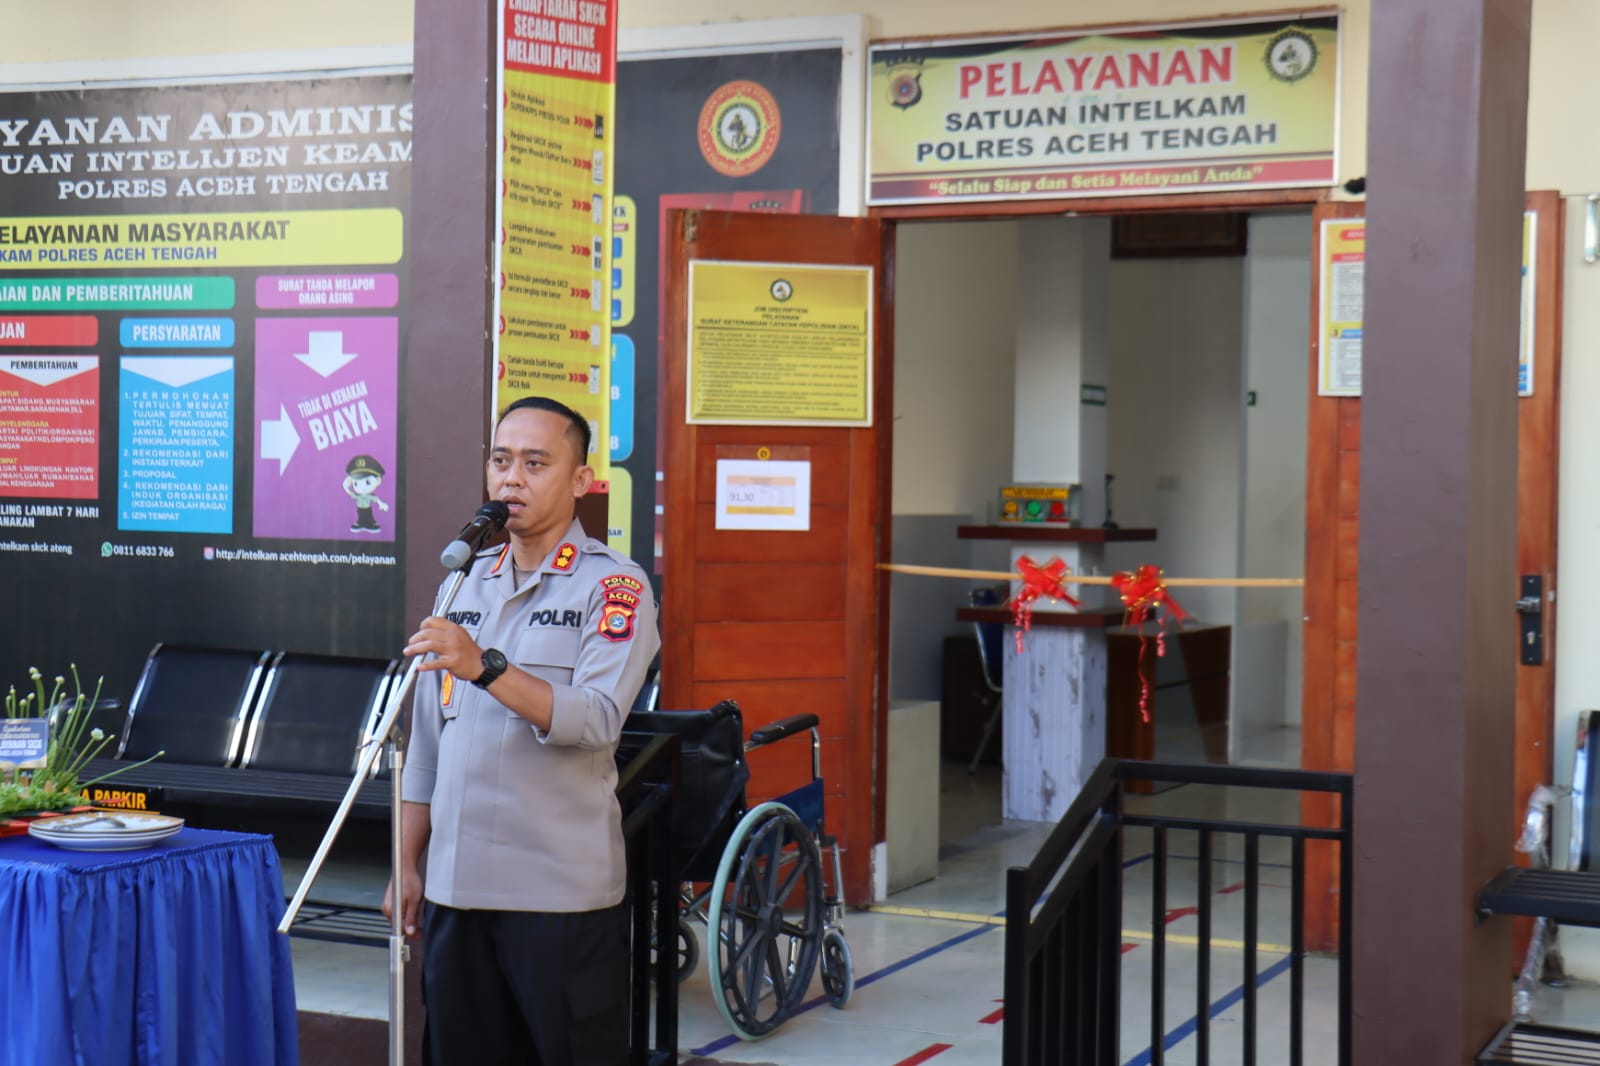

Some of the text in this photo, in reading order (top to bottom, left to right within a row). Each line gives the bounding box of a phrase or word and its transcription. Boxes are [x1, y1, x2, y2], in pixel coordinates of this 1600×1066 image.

[579, 2, 606, 26] SKCK
[514, 14, 595, 48] SECARA ONLINE
[507, 39, 602, 74] MELALUI APLIKASI
[958, 46, 1233, 99] PELAYANAN
[945, 94, 1246, 132] SATUAN INTELKAM
[188, 104, 412, 142] ADMINIS
[916, 122, 1277, 162] POLRES ACEH TENGAH
[87, 146, 290, 173] INTELIJEN
[58, 171, 389, 200] POLRES ACEH TENGAH
[994, 177, 1031, 194] Siap
[1035, 176, 1067, 190] dan
[1071, 173, 1116, 189] Setia
[1120, 168, 1200, 188] Melayani
[0, 220, 290, 244] ELAYANAN MASYARAKAT
[38, 248, 98, 262] POLRES
[103, 246, 146, 262] ACEH
[152, 246, 218, 261] TENGAH
[32, 285, 61, 302] DAN
[66, 282, 193, 302] PEMBERITAHUAN
[278, 278, 375, 292] SURAT TANDA MELAPOR
[298, 292, 354, 305] ORANG ASING
[133, 324, 221, 342] PERSYARATAN
[10, 360, 78, 370] PEMBERITAHUAN
[133, 401, 229, 410] TERTULIS MEMUAT
[298, 380, 368, 418] TIDAK DI KENAKAN
[169, 420, 229, 428] PENANGGUNG
[308, 400, 378, 451] BIAYA
[132, 438, 180, 446] PERKIRAAN
[132, 450, 200, 458] REKOMENDASI
[206, 450, 228, 459] DARI
[132, 470, 176, 479] PROPOSAL
[136, 482, 202, 490] REKOMENDASI
[206, 483, 228, 492] DARI
[132, 491, 228, 501] INDUK ORGANISASI
[24, 505, 64, 517] LAMBAT
[66, 506, 72, 517] 7
[76, 506, 99, 518] HARI
[132, 512, 147, 520] IZIN
[148, 513, 180, 521] TEMPAT
[31, 542, 48, 552] skck
[50, 544, 72, 555] ateng
[114, 545, 174, 558] 0811 6833 766
[279, 551, 396, 566] acehtengah.com/pelayanan
[608, 592, 635, 604] ACEH
[528, 608, 582, 628] POLRI
[94, 788, 146, 810] PARKIR
